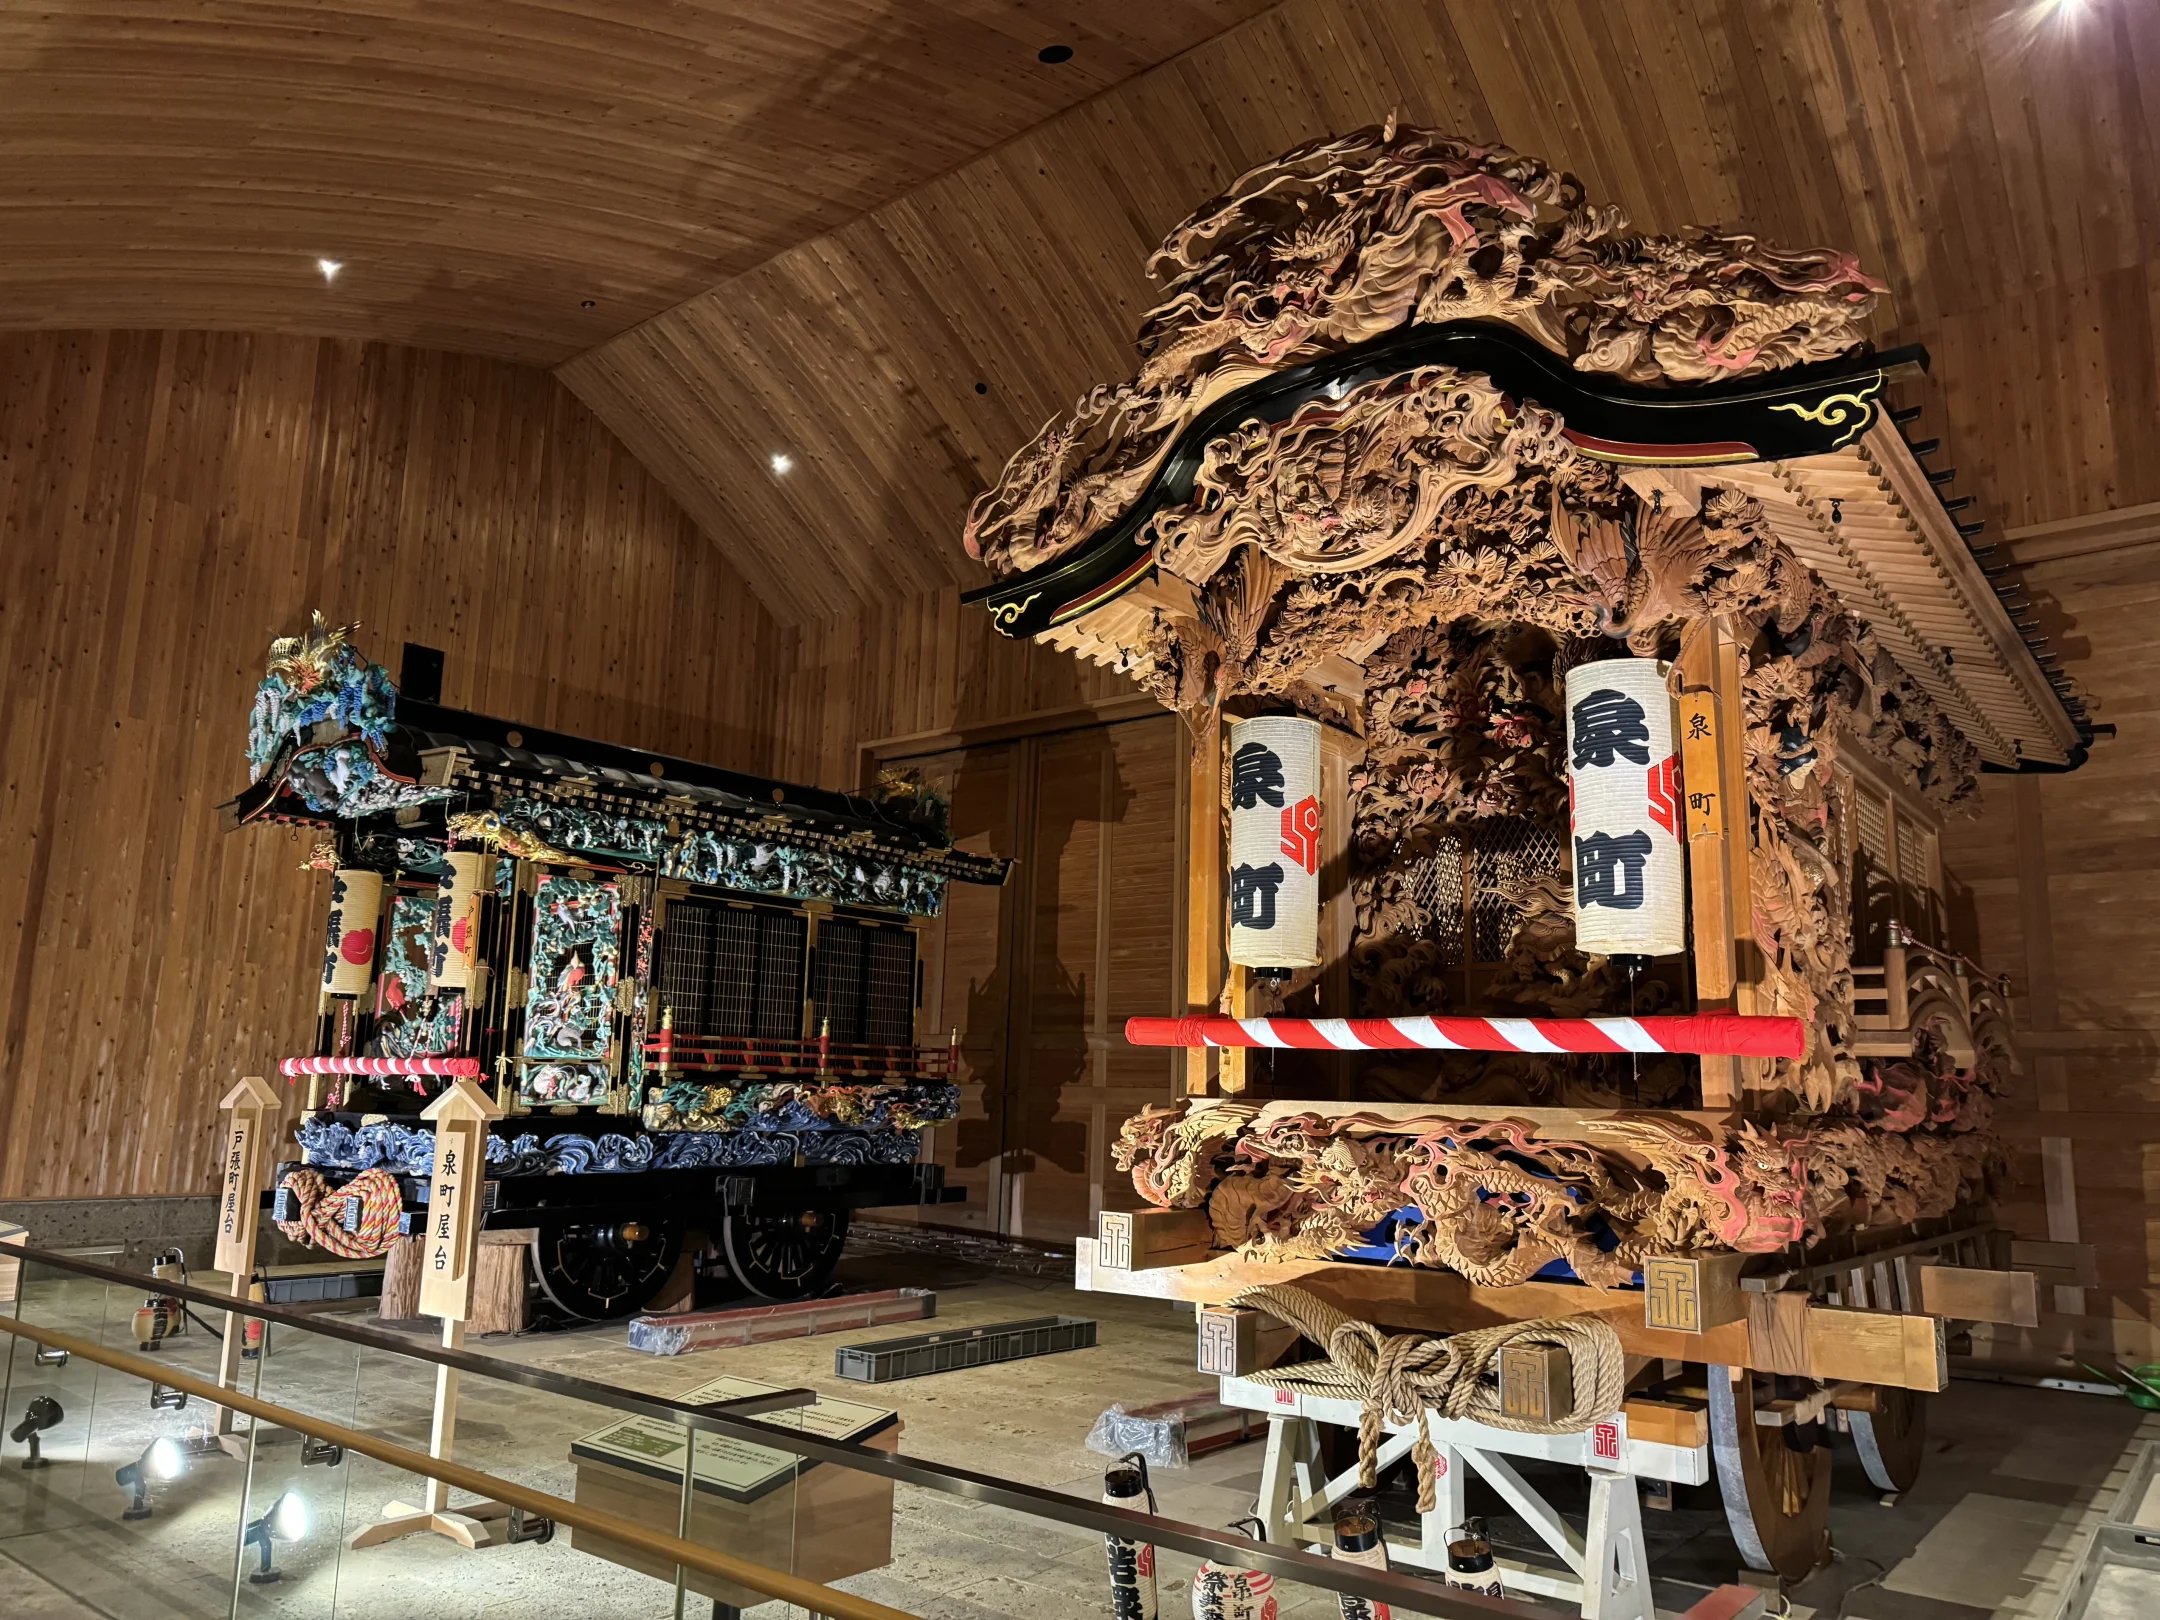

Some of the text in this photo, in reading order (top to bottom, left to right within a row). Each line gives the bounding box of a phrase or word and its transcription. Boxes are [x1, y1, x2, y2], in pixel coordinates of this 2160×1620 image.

[1572, 689, 1652, 910] 泉町
[1687, 712, 1716, 816] 泉町
[1232, 742, 1285, 930] 泉町
[224, 1130, 244, 1234] 戸張町屋台
[434, 1150, 457, 1270] 泉町屋台
